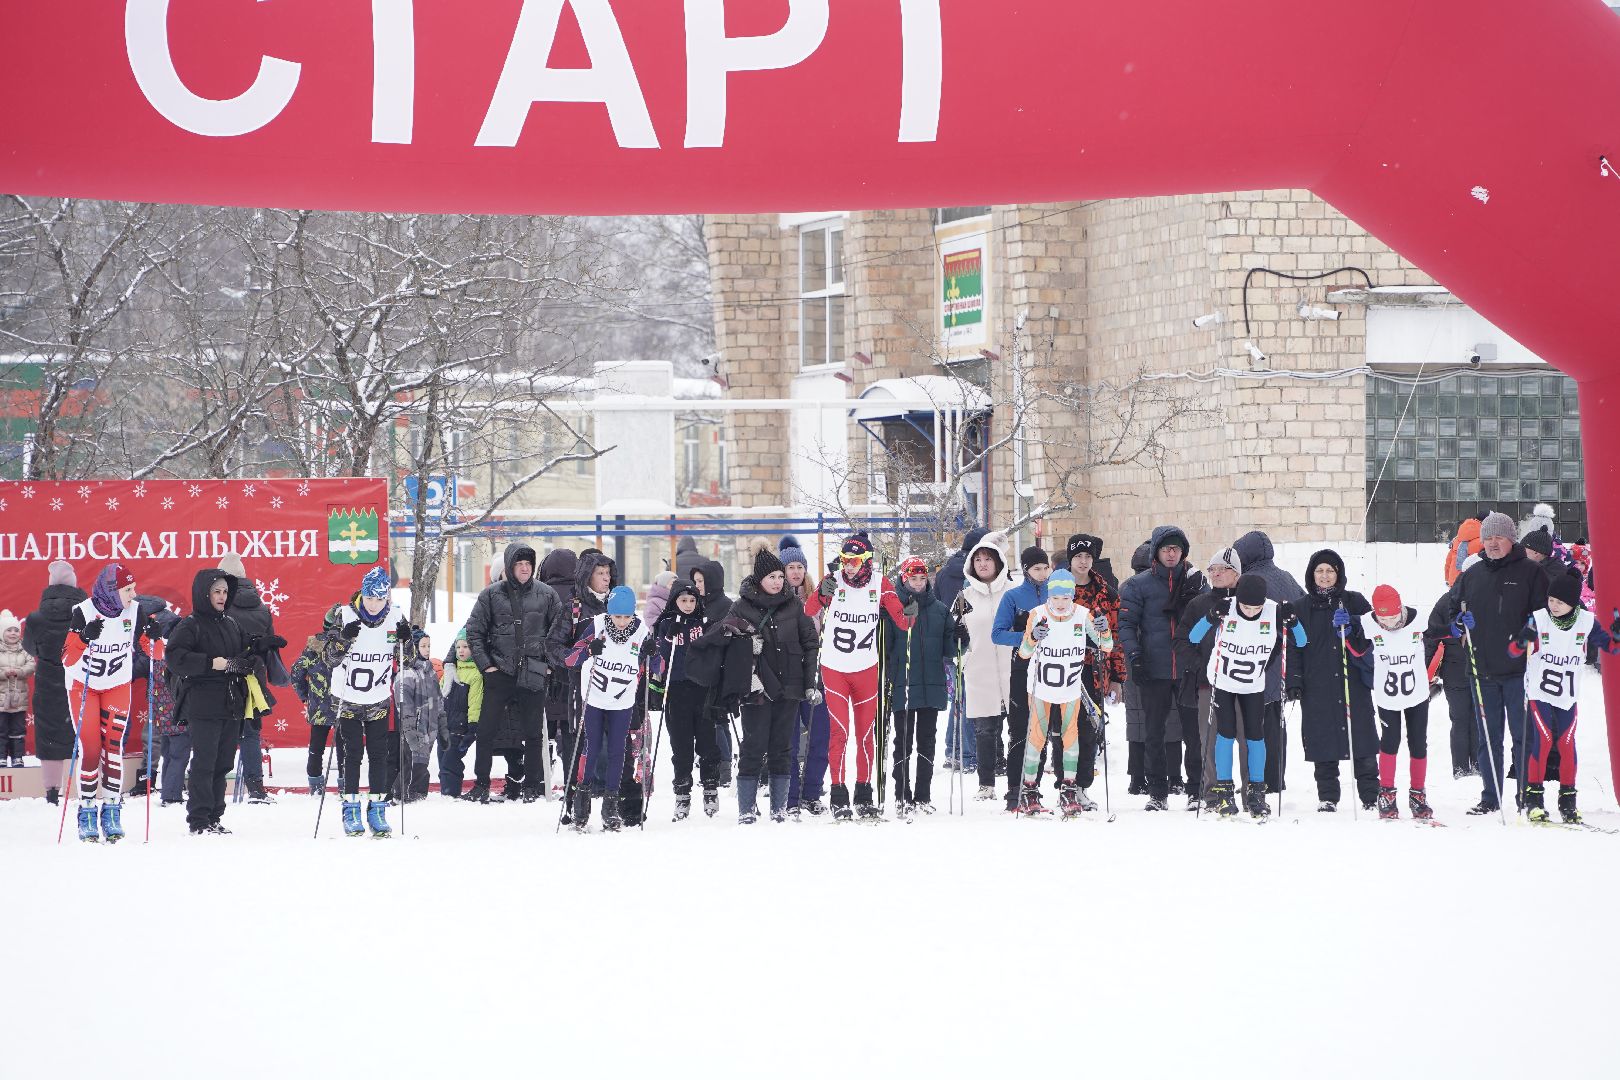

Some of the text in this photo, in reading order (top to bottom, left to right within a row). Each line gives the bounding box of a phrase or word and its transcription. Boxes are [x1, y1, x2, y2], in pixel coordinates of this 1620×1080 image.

[186, 529, 318, 558] ЛЫЖНЯ
[833, 627, 875, 653] 84
[1035, 660, 1085, 687] 102
[1220, 655, 1267, 683] 121
[1384, 669, 1416, 697] 80
[1540, 668, 1575, 697] 81
